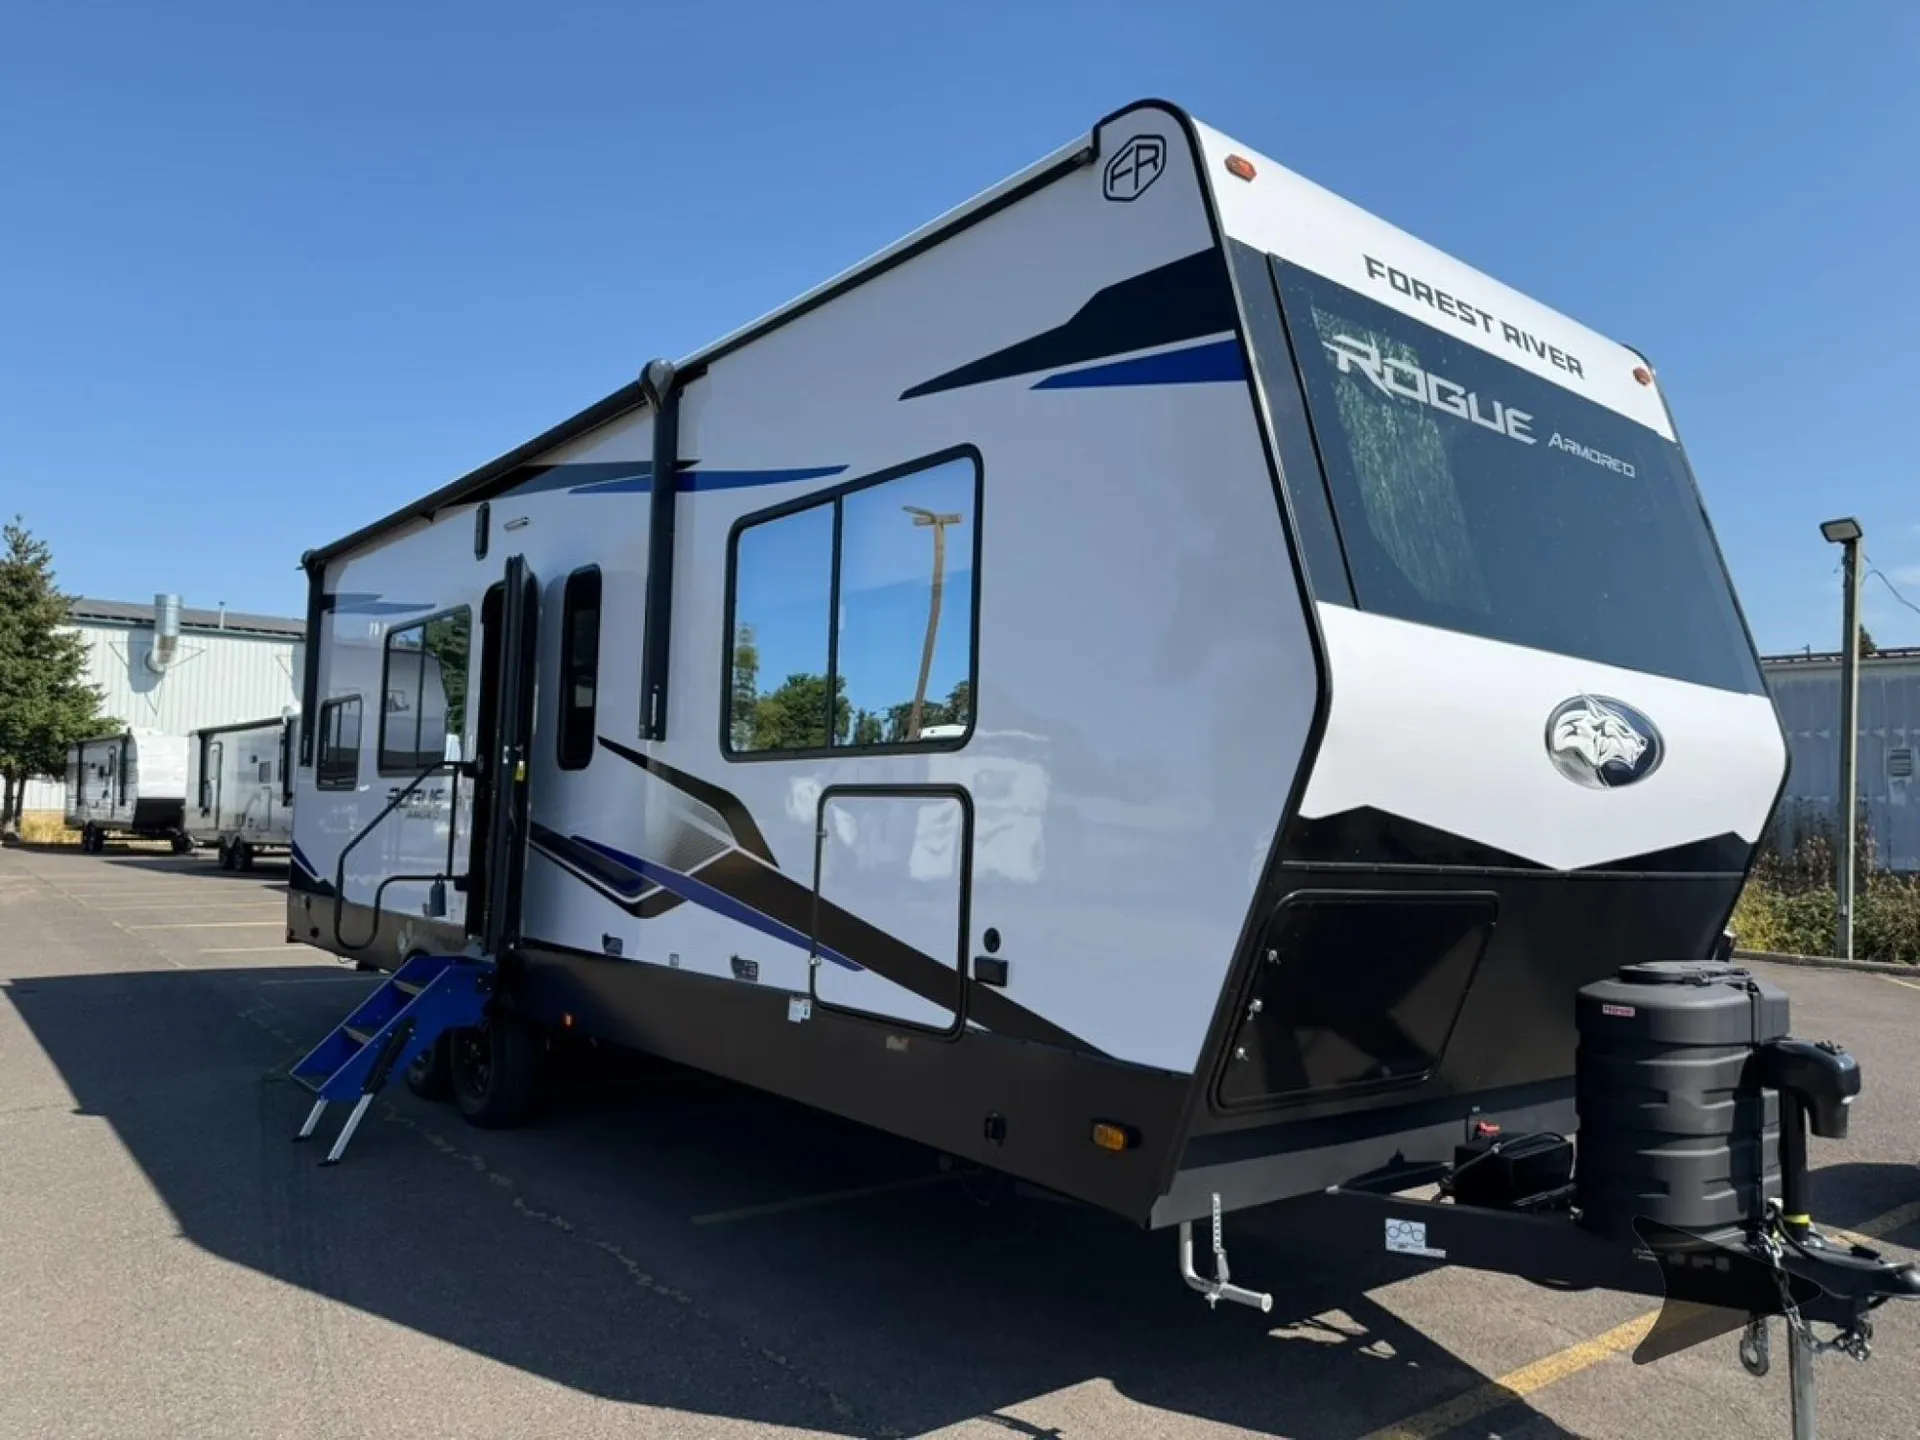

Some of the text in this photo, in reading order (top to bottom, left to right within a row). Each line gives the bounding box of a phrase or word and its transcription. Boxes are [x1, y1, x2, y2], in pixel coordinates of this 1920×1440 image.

[1109, 143, 1160, 191] FR
[1363, 253, 1585, 380] FOREST RIVER
[1321, 331, 1537, 445] ROGUE
